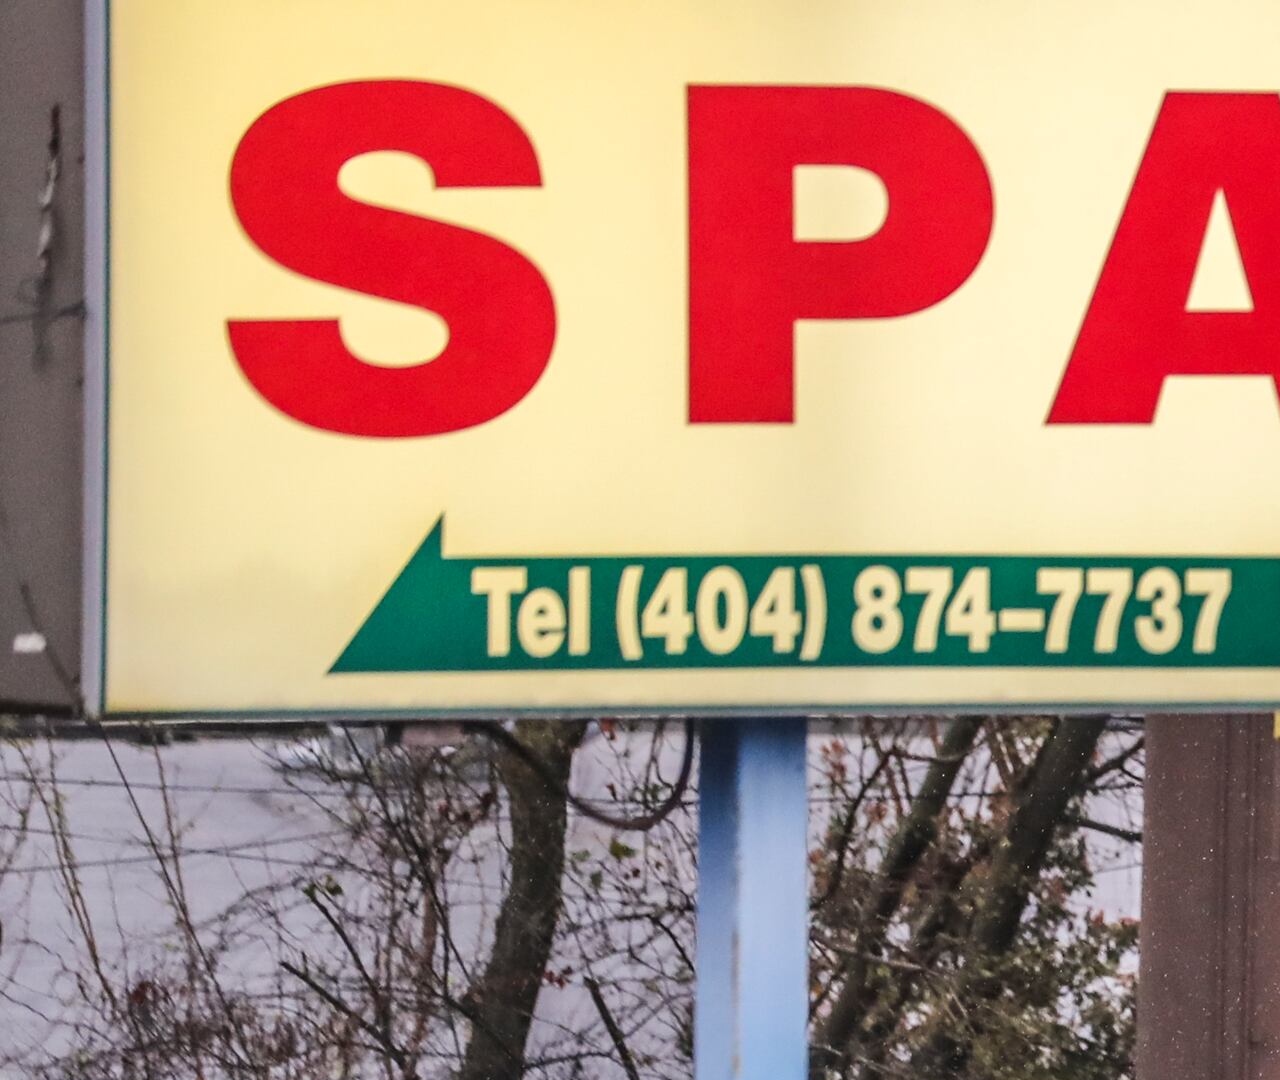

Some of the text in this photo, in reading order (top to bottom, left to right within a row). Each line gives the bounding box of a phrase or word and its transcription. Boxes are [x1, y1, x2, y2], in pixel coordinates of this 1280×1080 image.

[471, 564, 1233, 662] Tel (404) 874-7737
